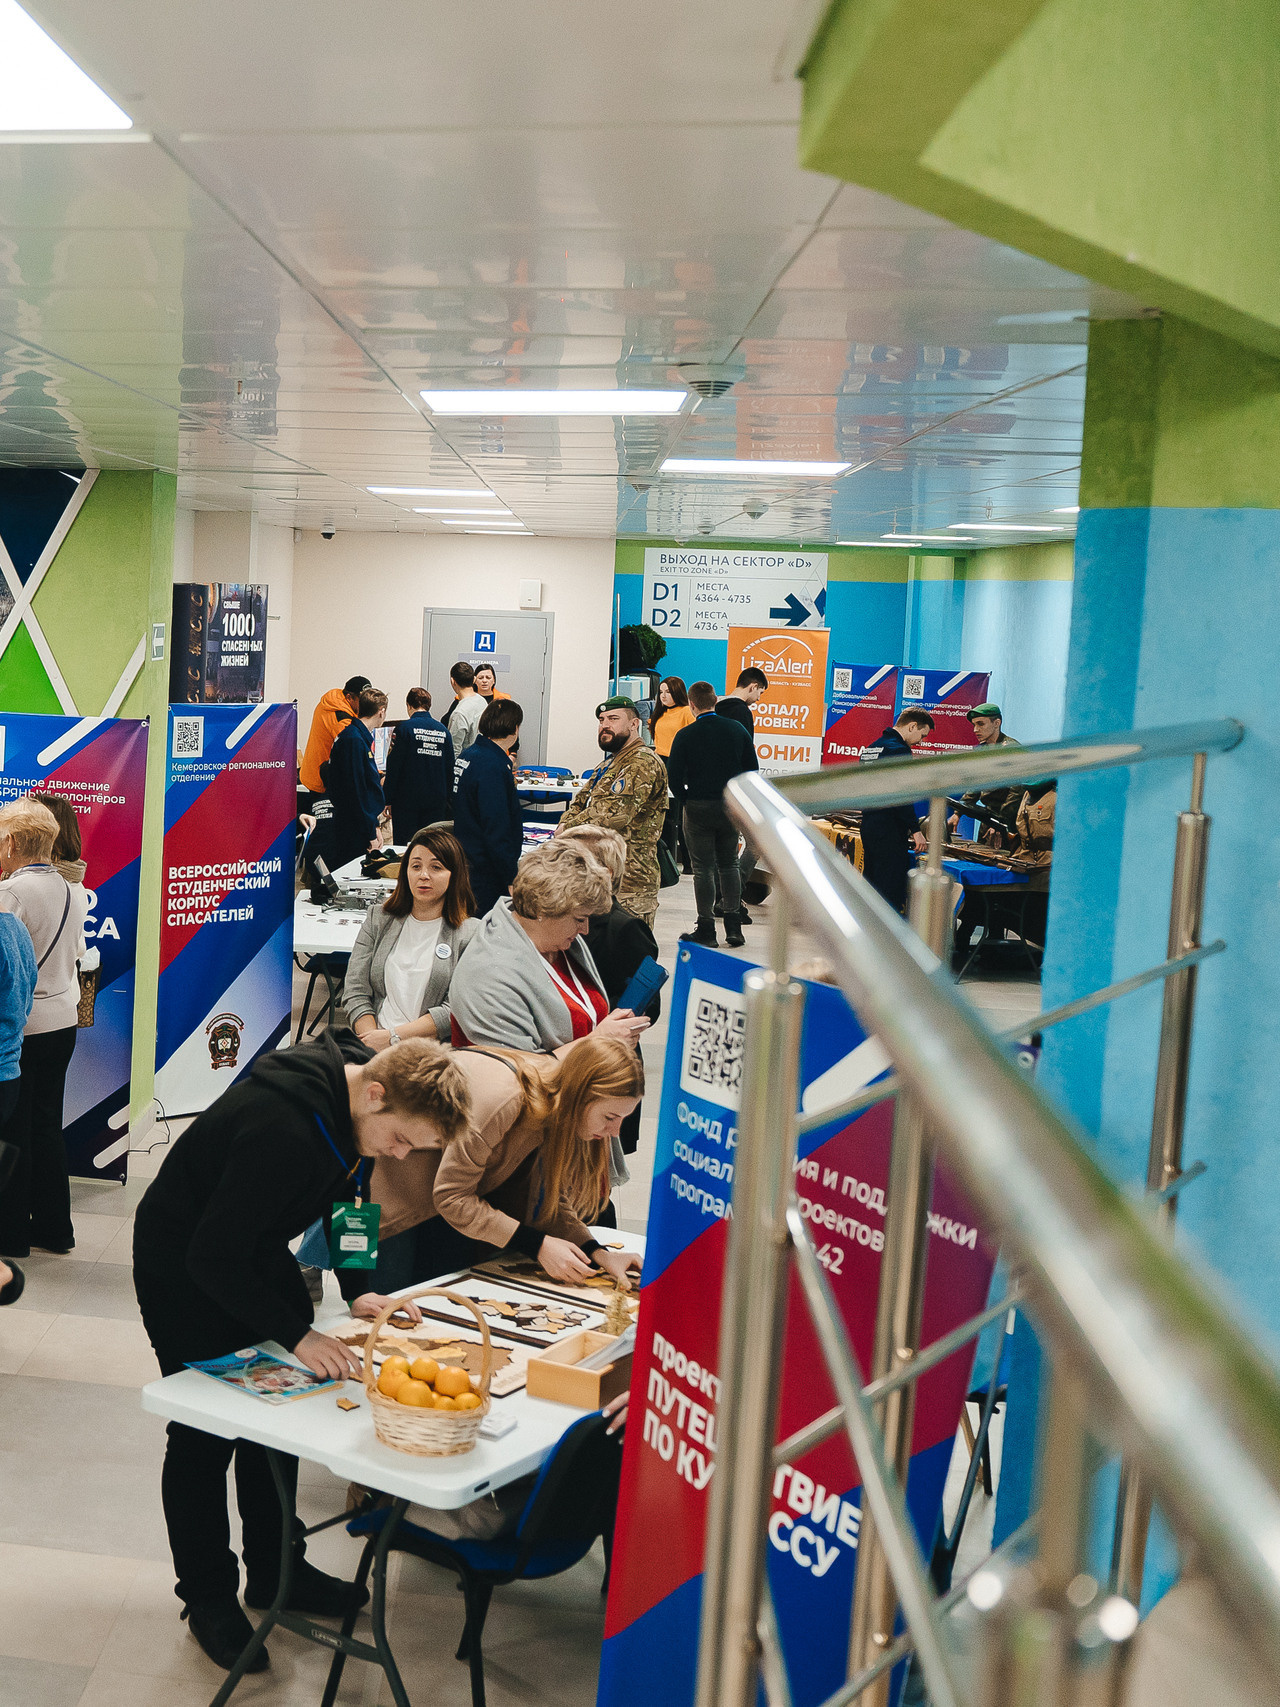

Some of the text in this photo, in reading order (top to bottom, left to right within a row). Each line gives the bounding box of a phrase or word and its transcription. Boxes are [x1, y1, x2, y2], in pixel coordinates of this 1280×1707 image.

[660, 553, 812, 568] ВЫХОД НА СЕКТОР «D»
[653, 582, 678, 602] D1
[697, 583, 729, 591] МЕСТА
[695, 594, 719, 603] 4364
[727, 594, 751, 604] 4735
[651, 608, 681, 627] D2
[695, 611, 728, 620] МЕСТА
[222, 613, 256, 637] 1000
[694, 622, 718, 631] 4736
[477, 633, 492, 650] Д
[220, 653, 249, 667] ЖИЗНЕЙ
[755, 743, 811, 763] ОНИ!
[171, 761, 286, 772] Кемеровское региональное
[47, 780, 110, 792] движение
[171, 774, 216, 782] отделение
[168, 857, 282, 880] ВСЕРОССИЙСКИЙ
[167, 873, 271, 896] СТУДЕНЧЕСКИЙ
[167, 894, 221, 911] КОРПУС
[166, 905, 255, 927] СПАСАТЕЛЕЙ
[676, 1101, 723, 1144] Фонд
[643, 1408, 675, 1462] ПО
